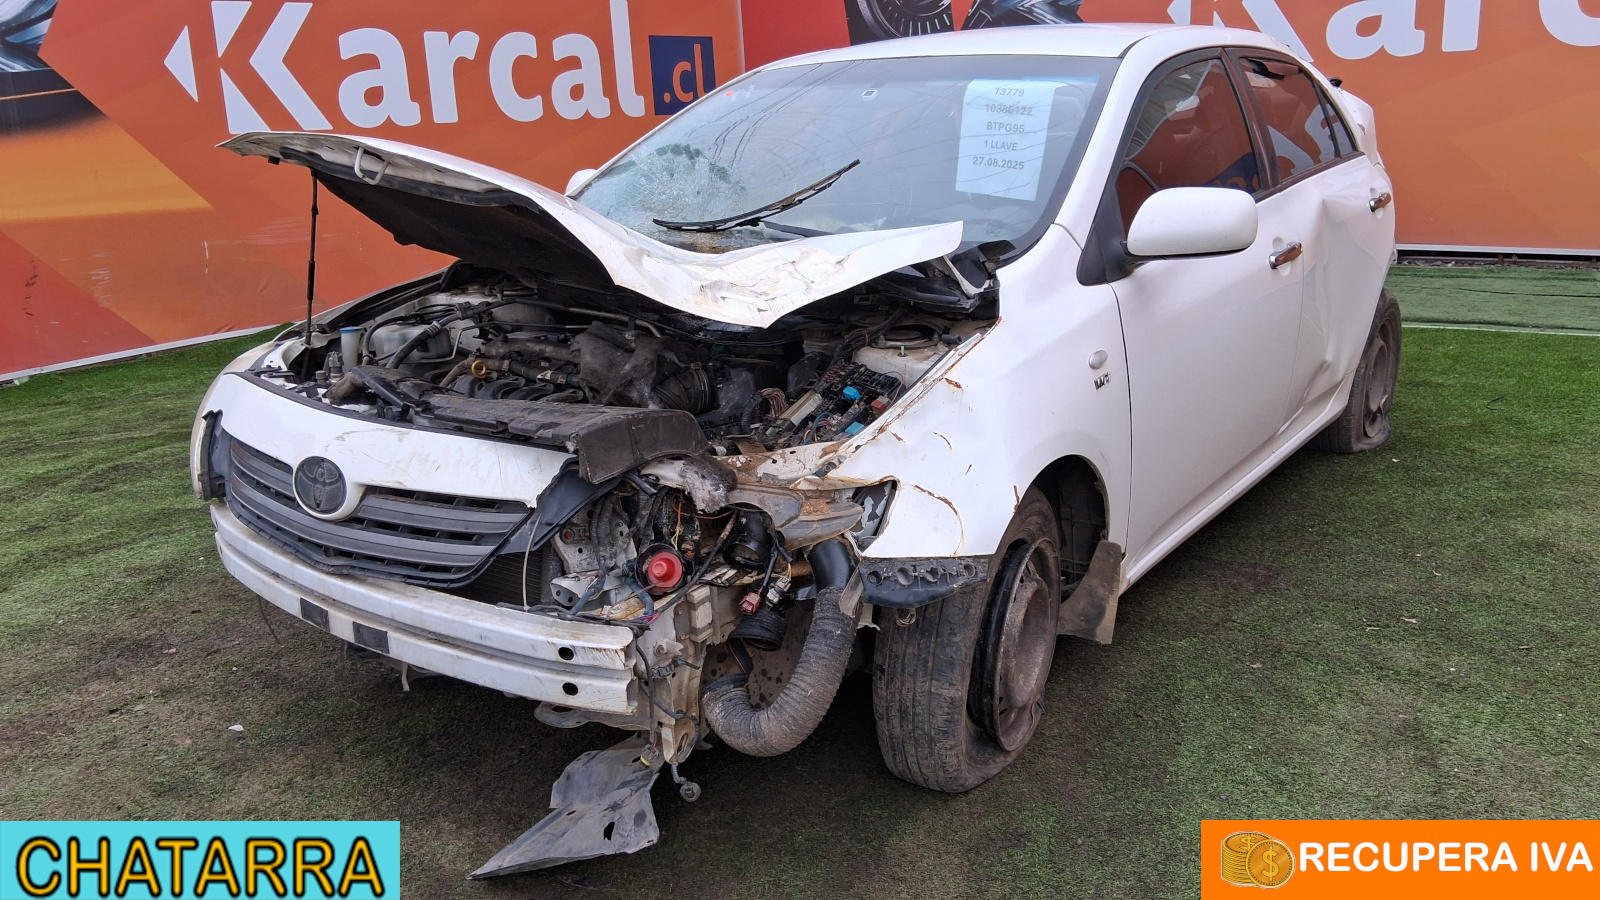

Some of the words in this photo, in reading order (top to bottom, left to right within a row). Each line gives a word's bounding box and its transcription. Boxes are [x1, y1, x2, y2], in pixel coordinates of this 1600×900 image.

[211, 0, 645, 134] Karcal
[995, 87, 1025, 98] 13779
[985, 103, 1033, 117] 10386122
[986, 121, 1025, 134] BTPG95
[983, 139, 989, 149] 1
[990, 140, 1018, 152] LLAVE
[972, 156, 1025, 171] 27.08.2025
